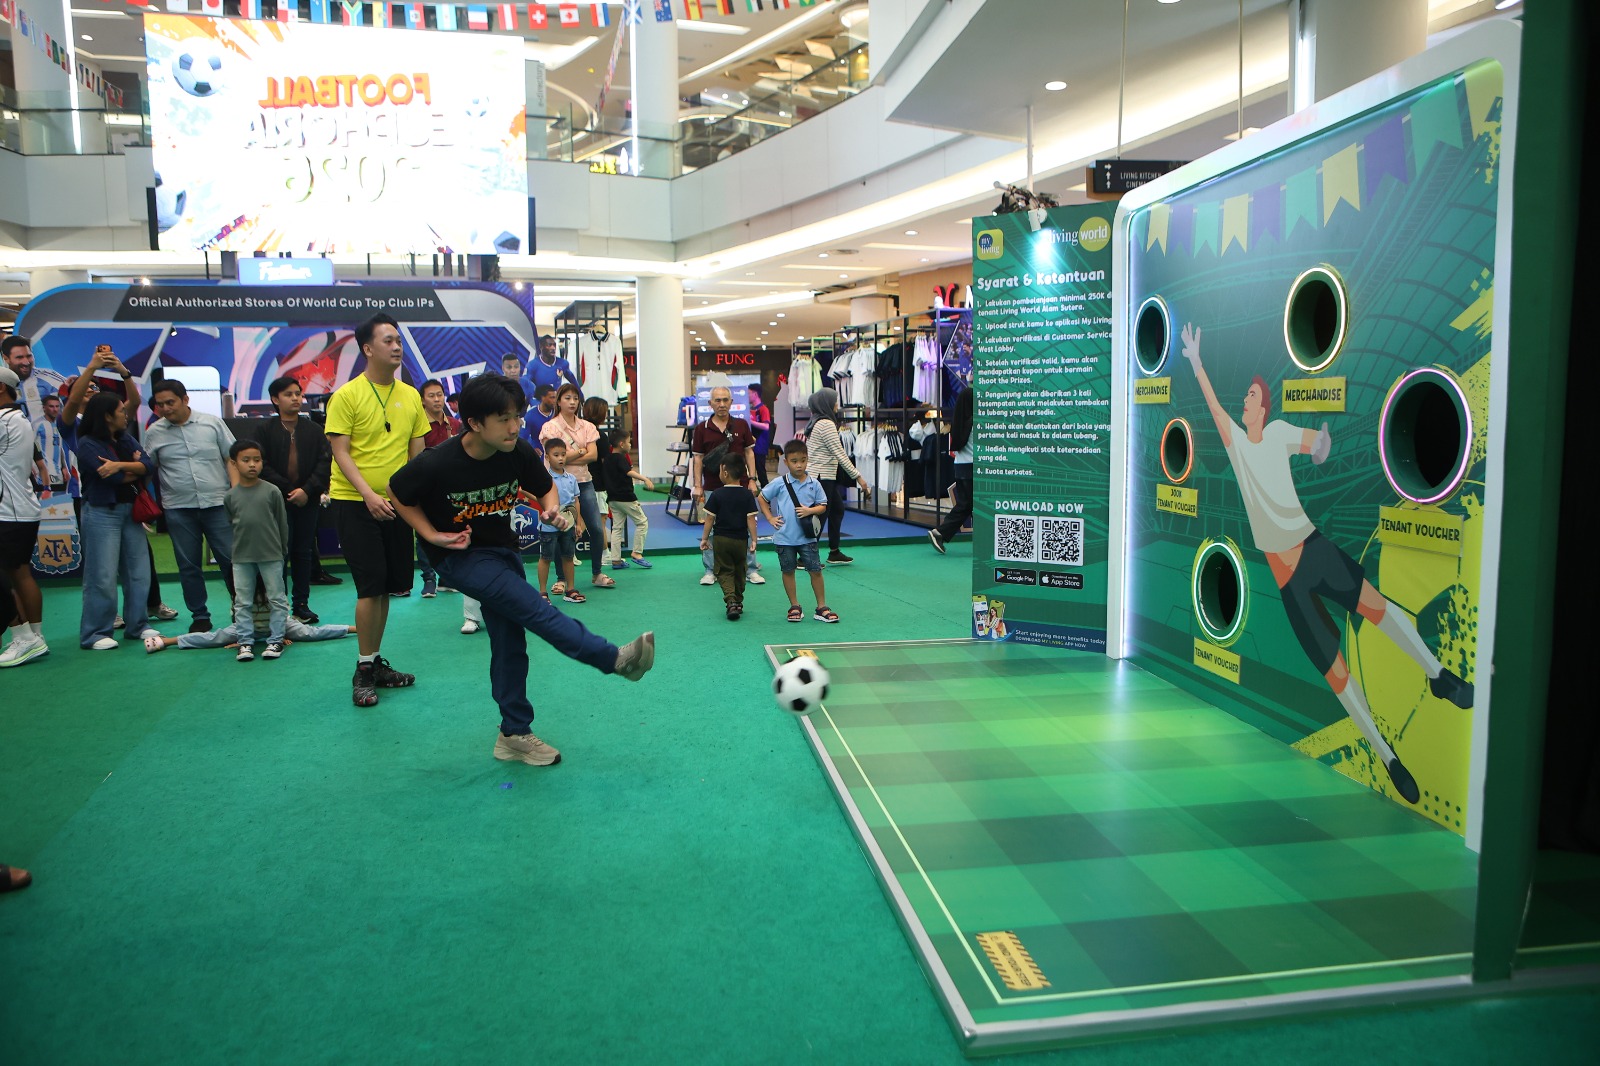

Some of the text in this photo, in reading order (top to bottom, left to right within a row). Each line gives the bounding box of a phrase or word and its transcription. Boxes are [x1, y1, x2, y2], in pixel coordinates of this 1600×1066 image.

[1080, 226, 1108, 240] world
[982, 245, 1000, 256] living
[978, 270, 1104, 290] Syarat & Ketentuan
[129, 297, 434, 310] Official Authorized Stores Of World Cup Top Club IPs
[1012, 296, 1058, 306] pembelanjaan
[1060, 294, 1086, 302] minimal
[986, 322, 1007, 331] Upload
[1055, 318, 1080, 327] aplikasi
[1094, 316, 1112, 324] Living
[716, 354, 754, 365] FUNG
[978, 368, 1020, 376] mendapatkan
[1022, 367, 1042, 376] kupon
[985, 391, 1021, 400] Pengunjung
[1135, 385, 1168, 396] MERCHANDISE
[1285, 388, 1342, 402] MERCHANDISE
[978, 400, 1016, 408] kesempatan
[987, 409, 1008, 417] lubang
[1074, 432, 1098, 440] lubang.
[1008, 446, 1039, 454] mengikuti
[995, 500, 1084, 514] DOWNLOAD NOW
[1158, 498, 1196, 512] TENANT VOUCHER
[1381, 518, 1460, 541] TENANT VOUCHER
[1195, 647, 1238, 673] TENANT VOUCHER
